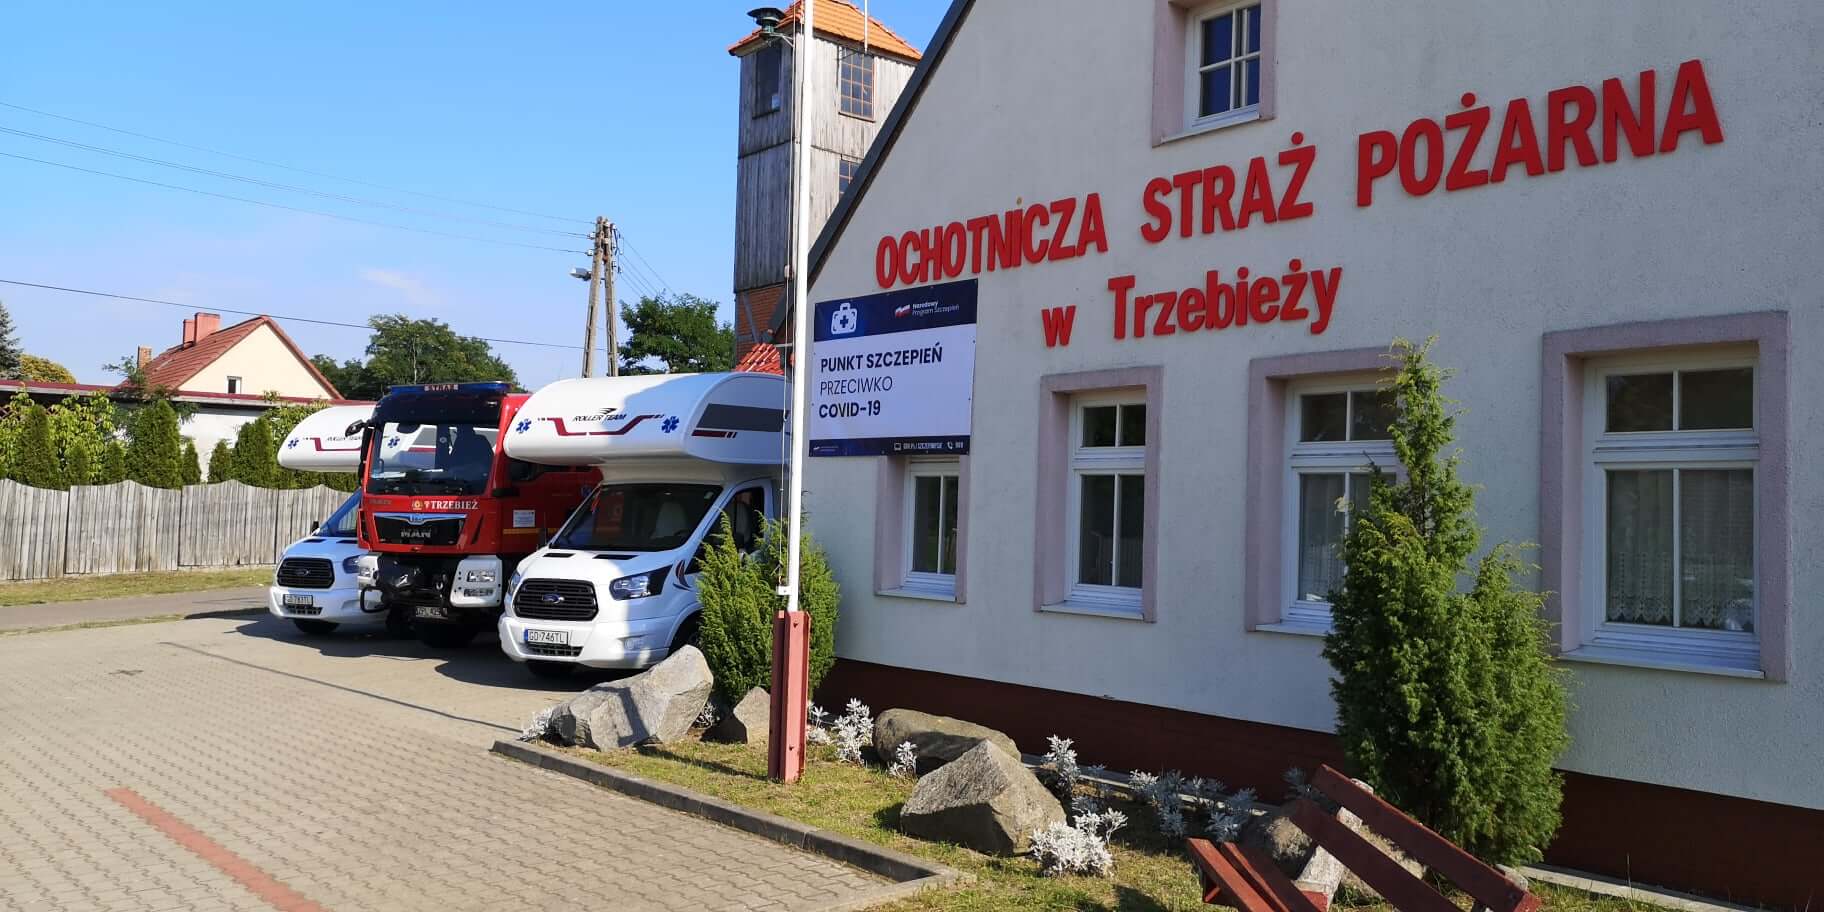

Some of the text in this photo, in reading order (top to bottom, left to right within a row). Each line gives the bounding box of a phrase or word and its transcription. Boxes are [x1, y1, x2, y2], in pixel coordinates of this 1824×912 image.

[875, 59, 1725, 289] OCHOTNICZA STRAŻ POŻARNA
[1041, 258, 1343, 348] w Trzebieży
[820, 342, 943, 373] PUNKT SZCZEPIEŃ
[819, 376, 893, 396] PRZECIWKO
[818, 400, 881, 418] COVID-19
[430, 499, 479, 510] TRZEBIEŻ
